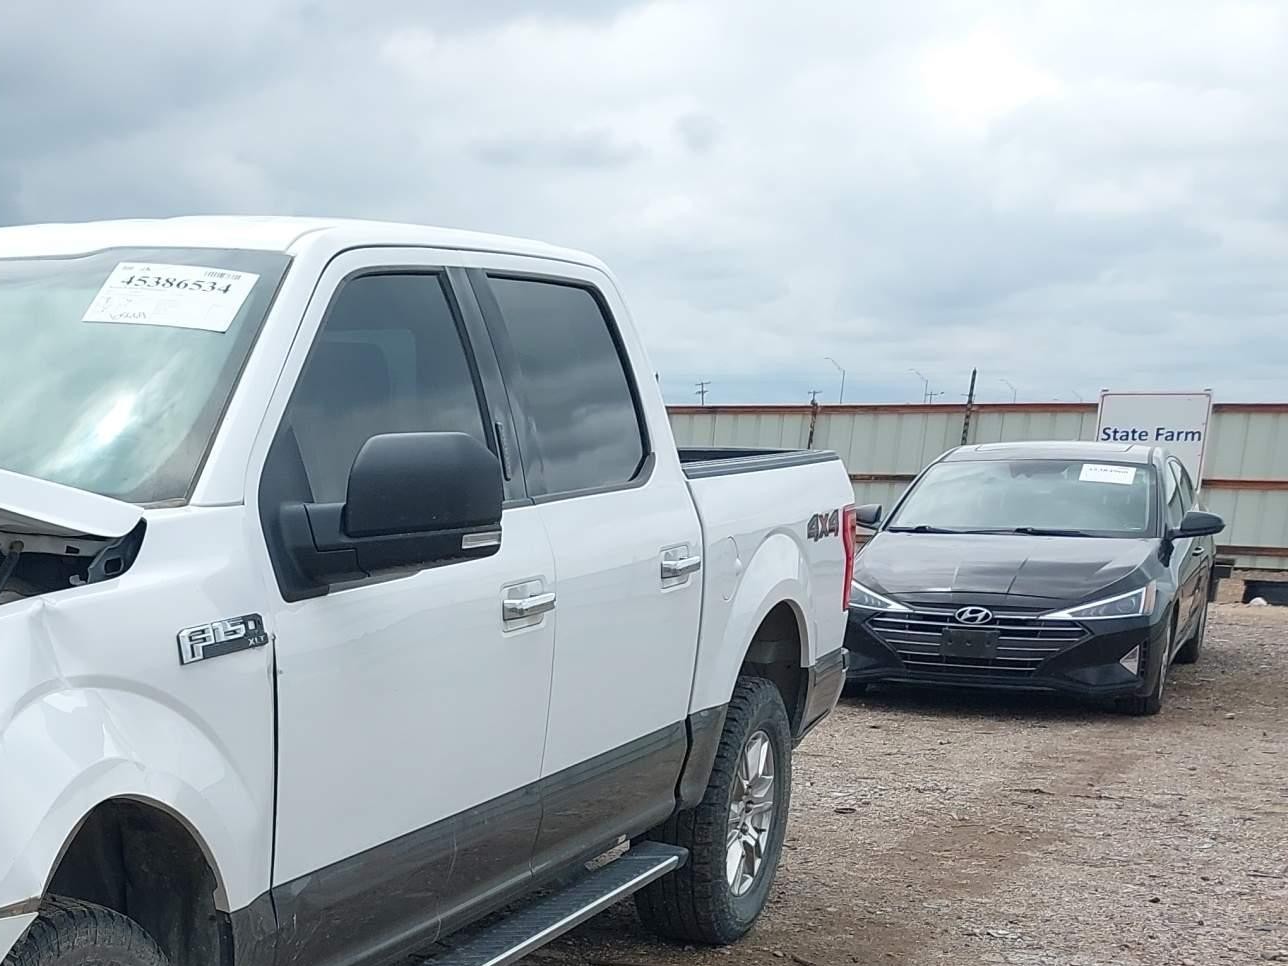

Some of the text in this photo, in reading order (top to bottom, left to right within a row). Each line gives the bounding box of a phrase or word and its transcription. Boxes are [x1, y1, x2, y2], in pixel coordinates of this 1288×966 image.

[120, 274, 232, 294] 45386534
[1101, 427, 1201, 442] State Farm
[248, 635, 265, 647] XLT
